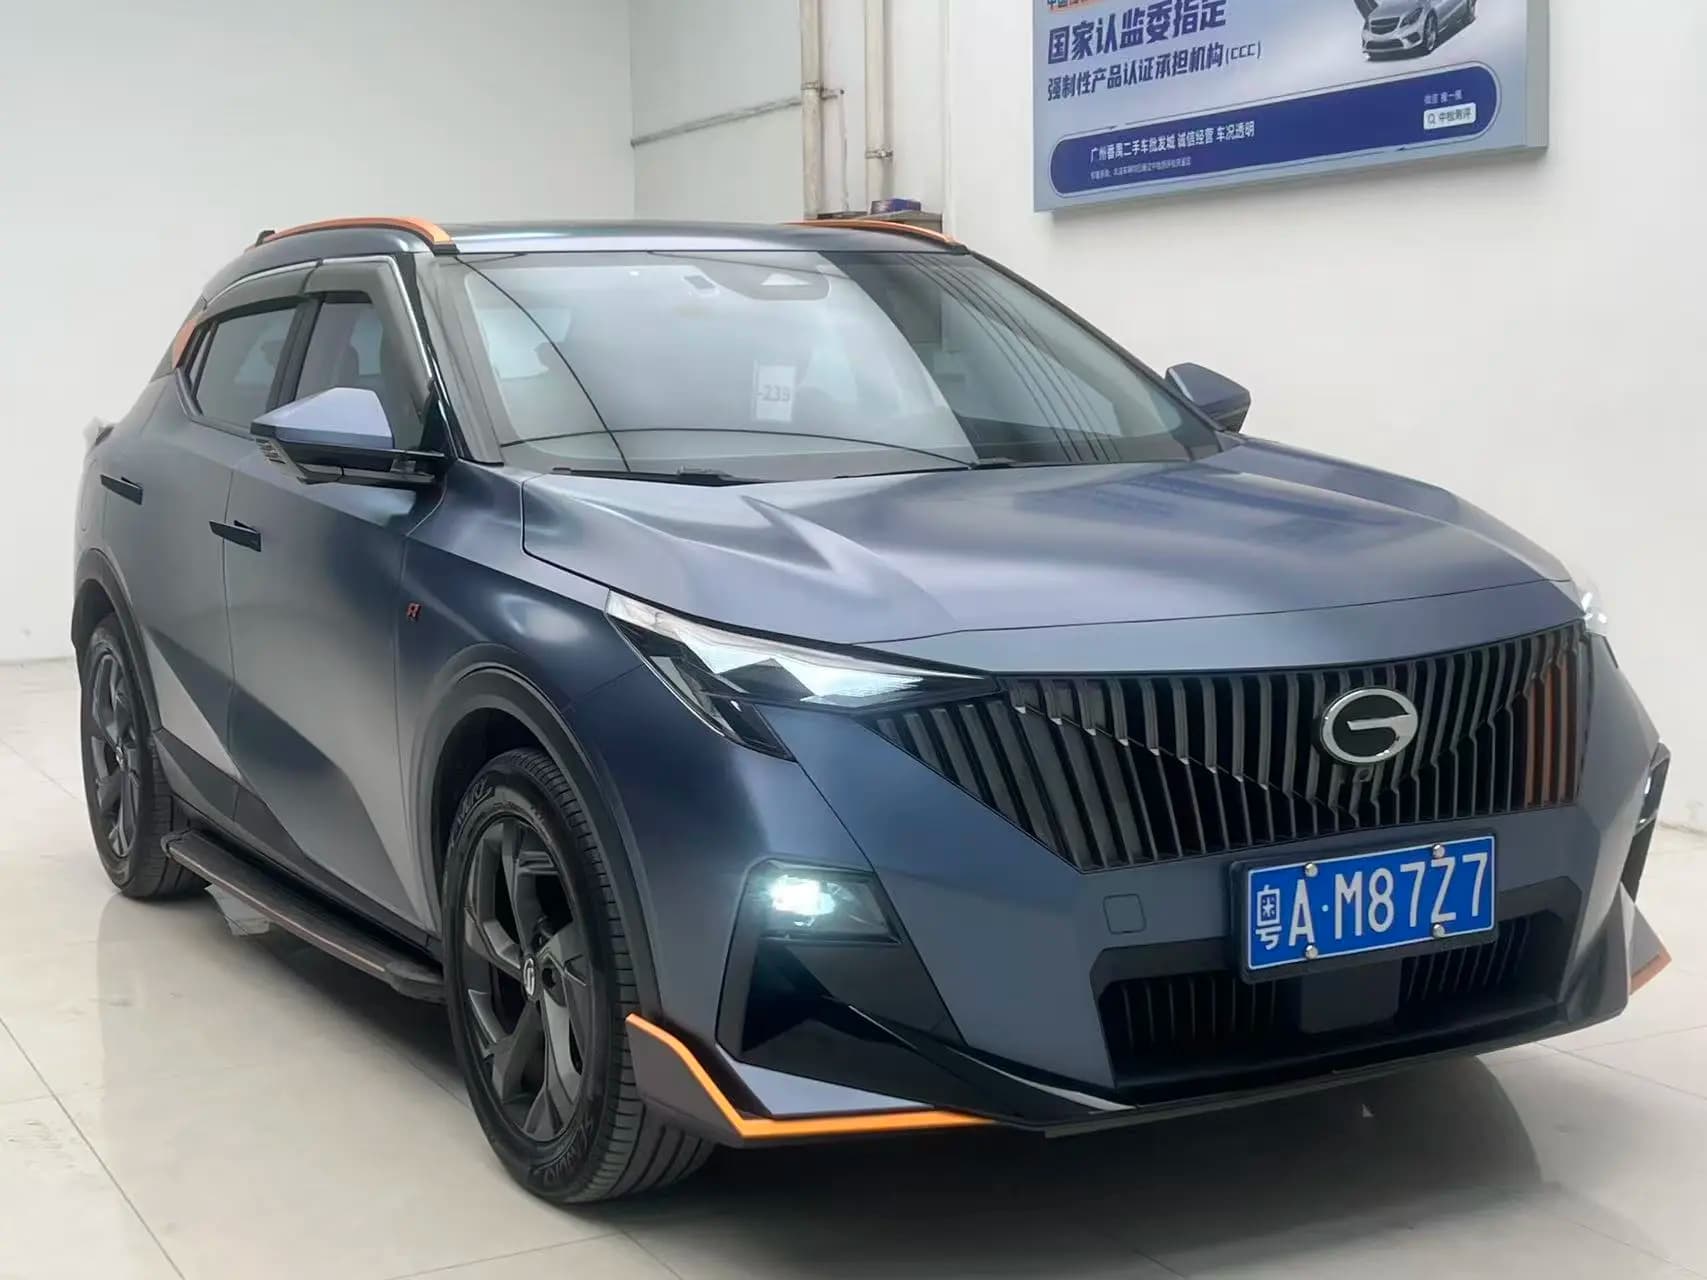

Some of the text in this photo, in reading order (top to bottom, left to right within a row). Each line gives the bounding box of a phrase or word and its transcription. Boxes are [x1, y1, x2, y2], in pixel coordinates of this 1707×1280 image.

[1047, 0, 1226, 64] 国家认监委指定
[1255, 852, 1488, 950] 粤A·M87Z7
